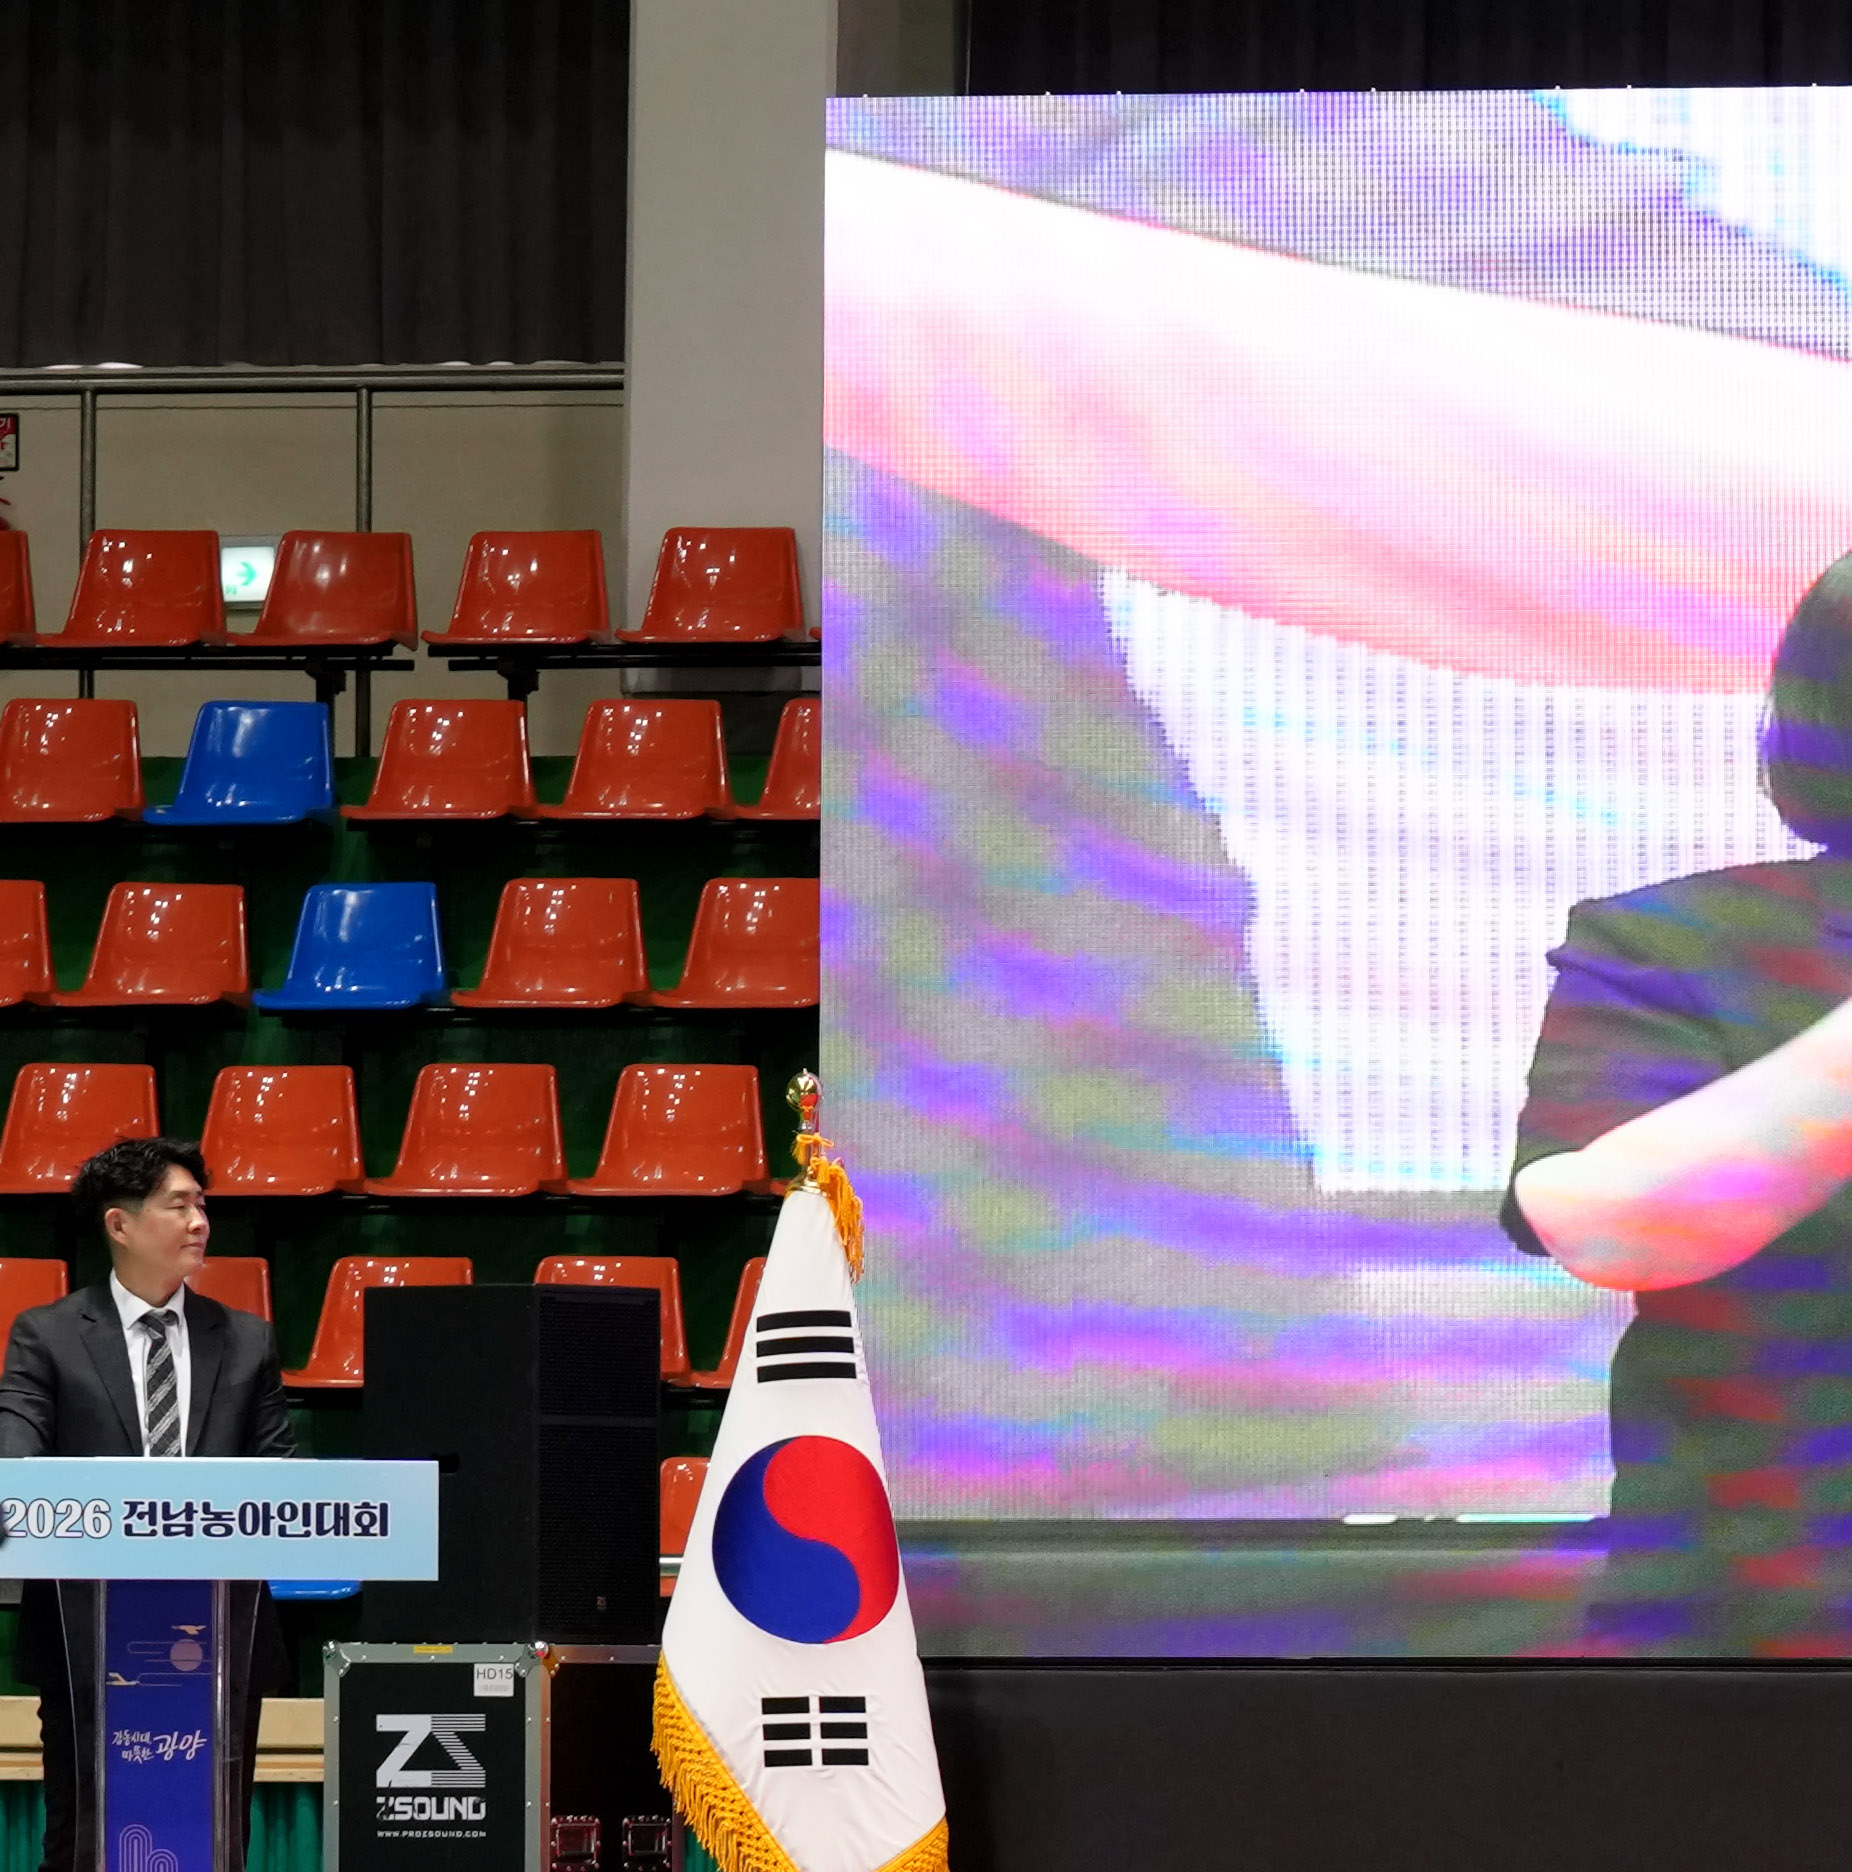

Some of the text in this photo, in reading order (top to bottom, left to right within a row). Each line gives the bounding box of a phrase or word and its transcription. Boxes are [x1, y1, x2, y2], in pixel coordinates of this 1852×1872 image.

[2, 1497, 391, 1539] 2026 전남농아인대회
[476, 1668, 513, 1680] HD15
[153, 1730, 207, 1760] 광양
